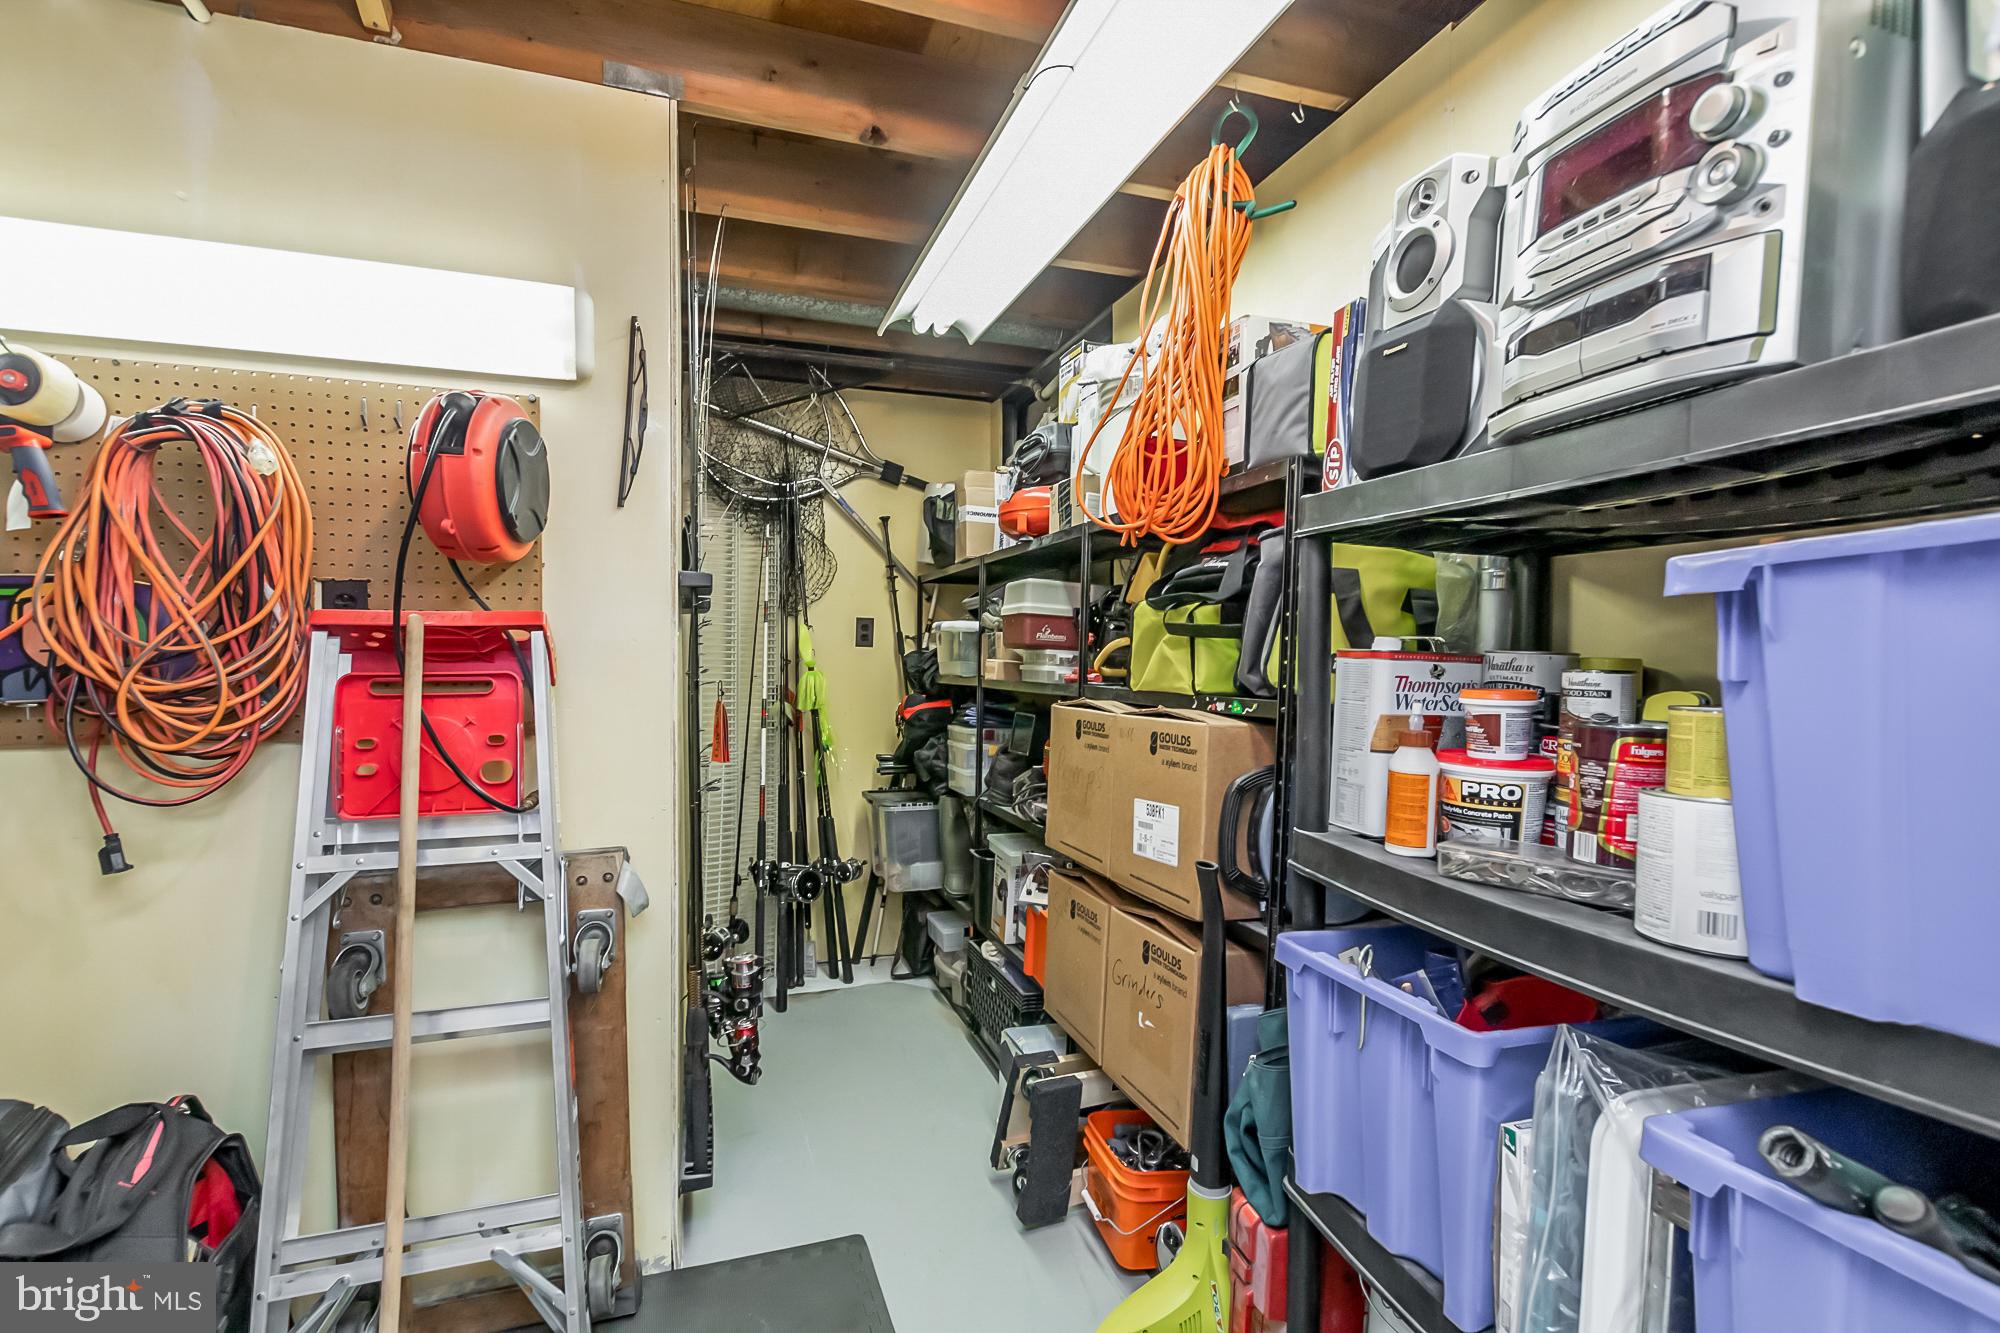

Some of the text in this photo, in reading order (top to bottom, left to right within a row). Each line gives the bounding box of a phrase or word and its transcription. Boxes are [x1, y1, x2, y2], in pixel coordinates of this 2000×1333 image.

[1327, 446, 1339, 481] STP
[1583, 690, 1608, 698] STAIN
[1082, 720, 1106, 733] GOULDS
[1159, 732, 1192, 747] GOULDS
[1630, 745, 1665, 758] Folgers
[1181, 760, 1198, 772] brand
[1461, 780, 1523, 801] PRO
[1465, 797, 1518, 807] SELECT
[1462, 808, 1493, 820] Concrete
[1493, 812, 1514, 821] Patch
[1077, 901, 1098, 923] GOULDS
[1150, 943, 1182, 971] GOULDS
[1112, 958, 1164, 1009] Grinders
